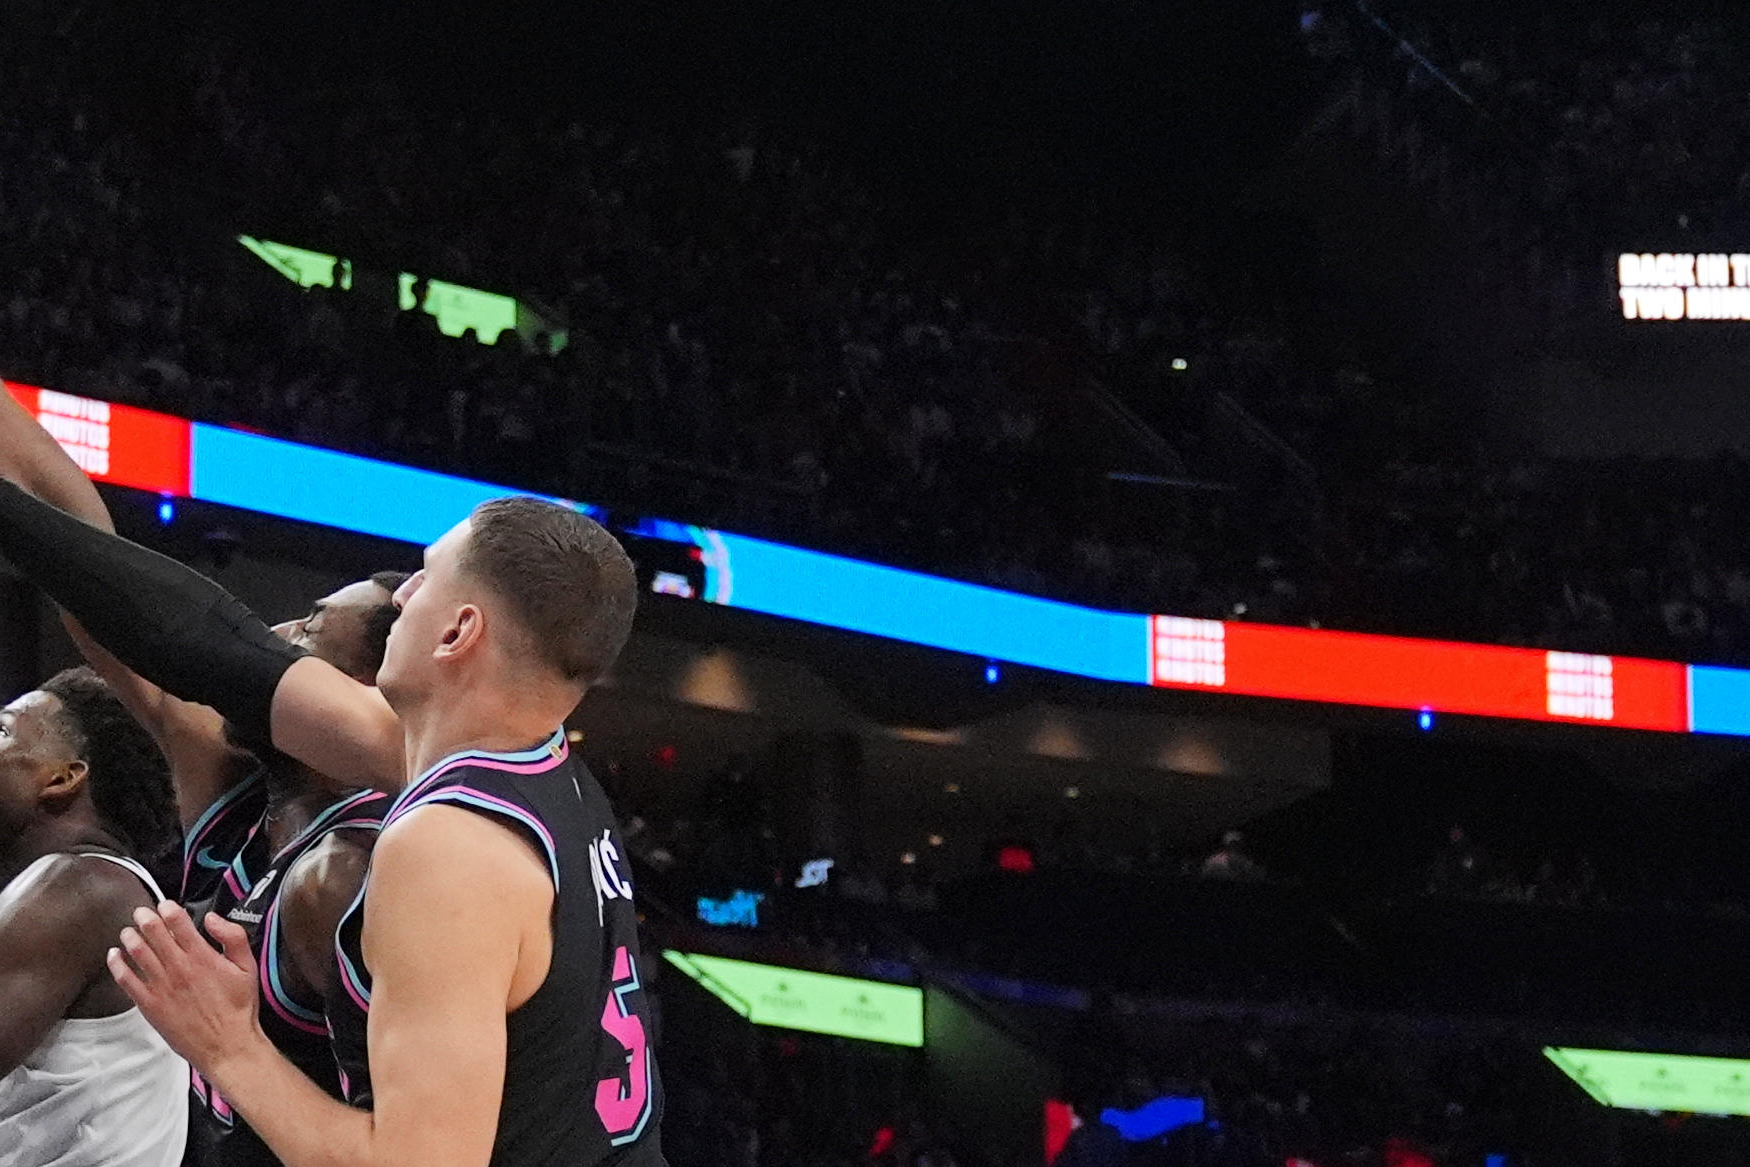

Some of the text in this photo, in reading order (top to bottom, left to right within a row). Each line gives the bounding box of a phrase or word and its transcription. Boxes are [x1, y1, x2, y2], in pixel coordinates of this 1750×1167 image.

[1618, 253, 1695, 287] BACK
[1696, 253, 1729, 287] IN
[1618, 286, 1684, 320] TWO
